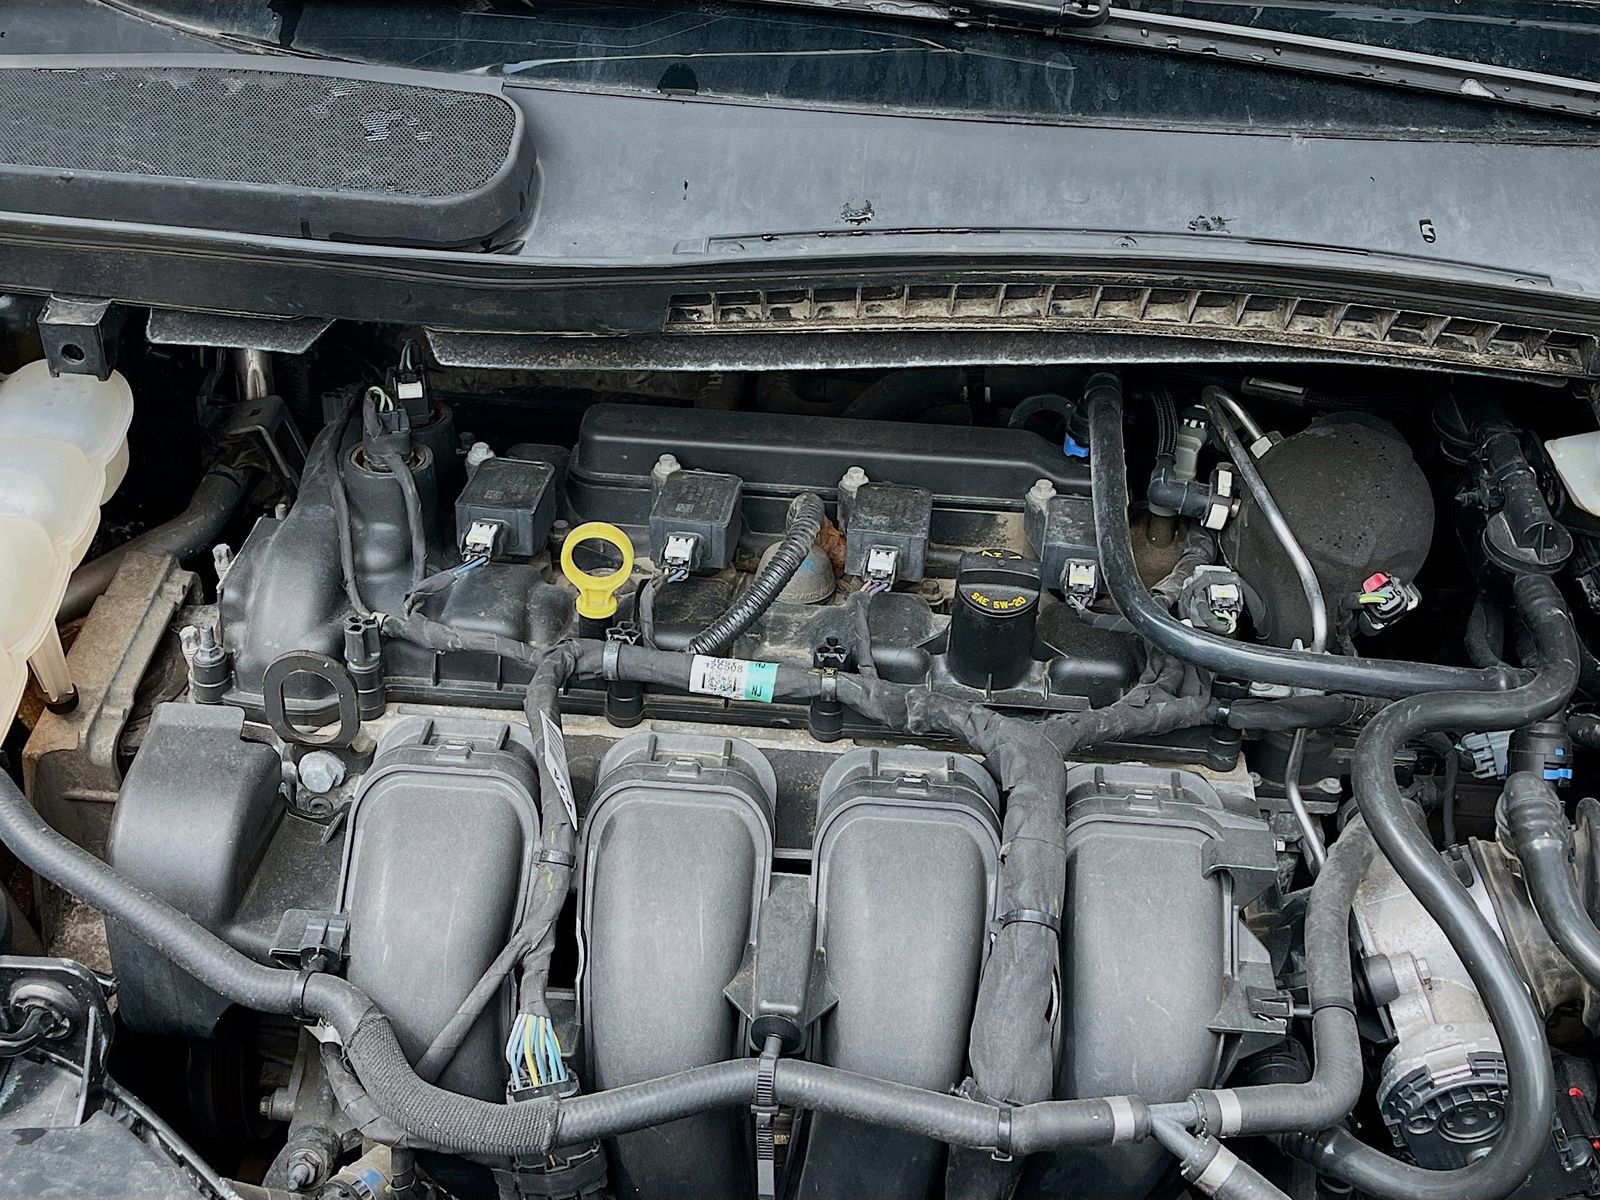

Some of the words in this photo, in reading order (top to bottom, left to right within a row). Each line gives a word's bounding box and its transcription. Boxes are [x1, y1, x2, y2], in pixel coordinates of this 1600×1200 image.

[971, 592, 990, 607] SAE
[992, 596, 1027, 609] 5W-20
[751, 685, 763, 697] NJ
